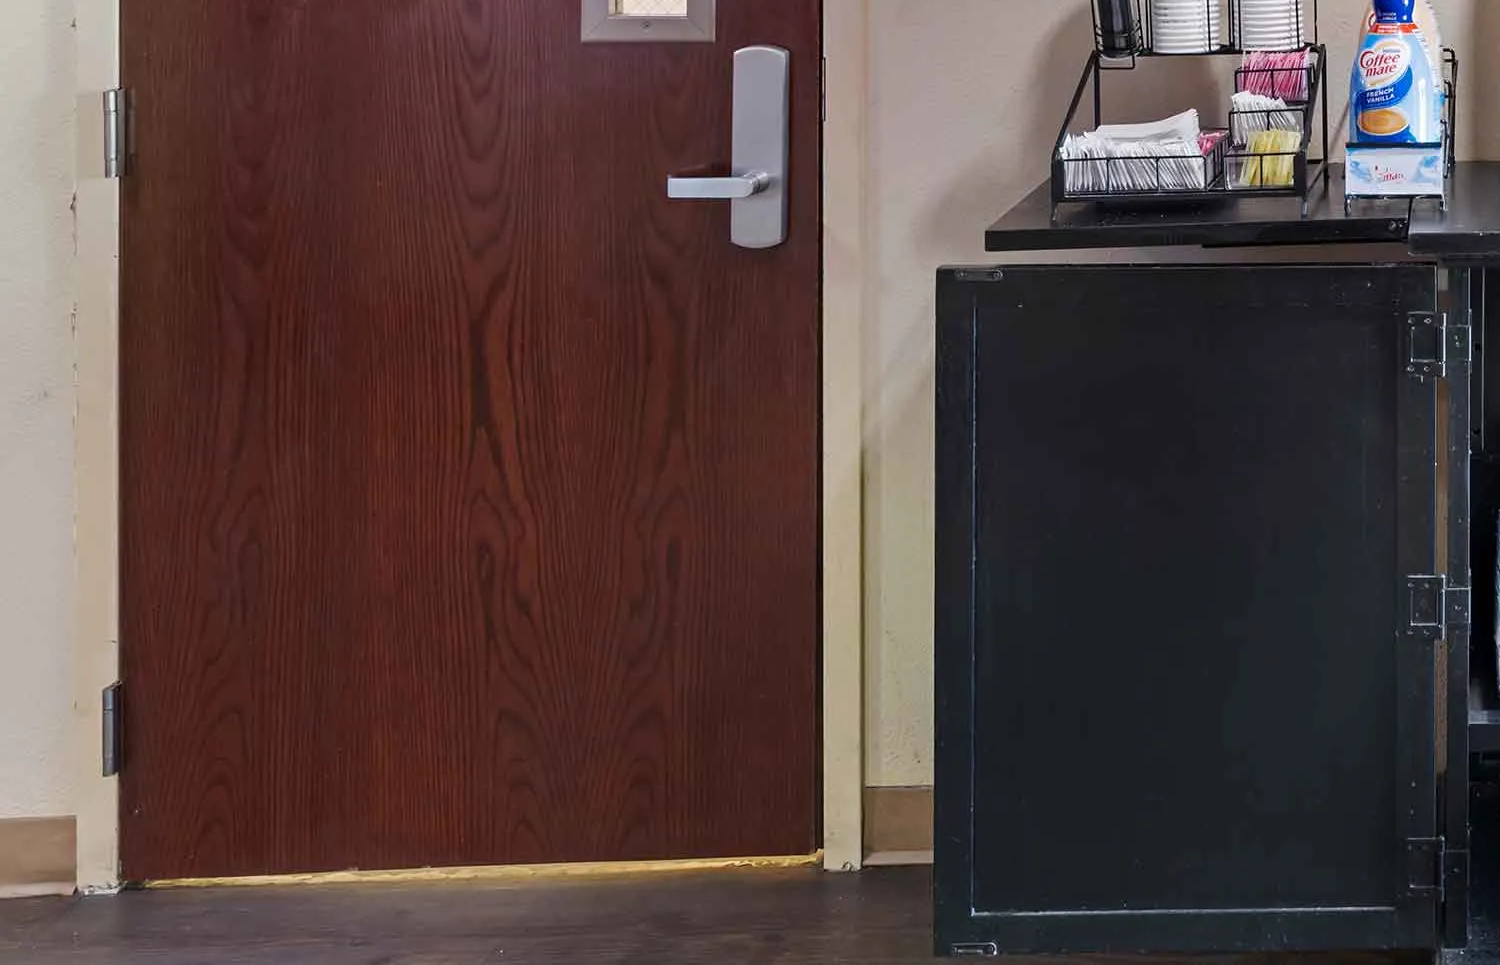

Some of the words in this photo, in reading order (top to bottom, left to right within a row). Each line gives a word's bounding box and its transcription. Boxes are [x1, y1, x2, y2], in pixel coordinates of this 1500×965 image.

[1360, 50, 1401, 69] Coffee
[1366, 64, 1397, 77] mate
[1366, 87, 1394, 97] FRENCH
[1366, 93, 1395, 104] VANILLA
